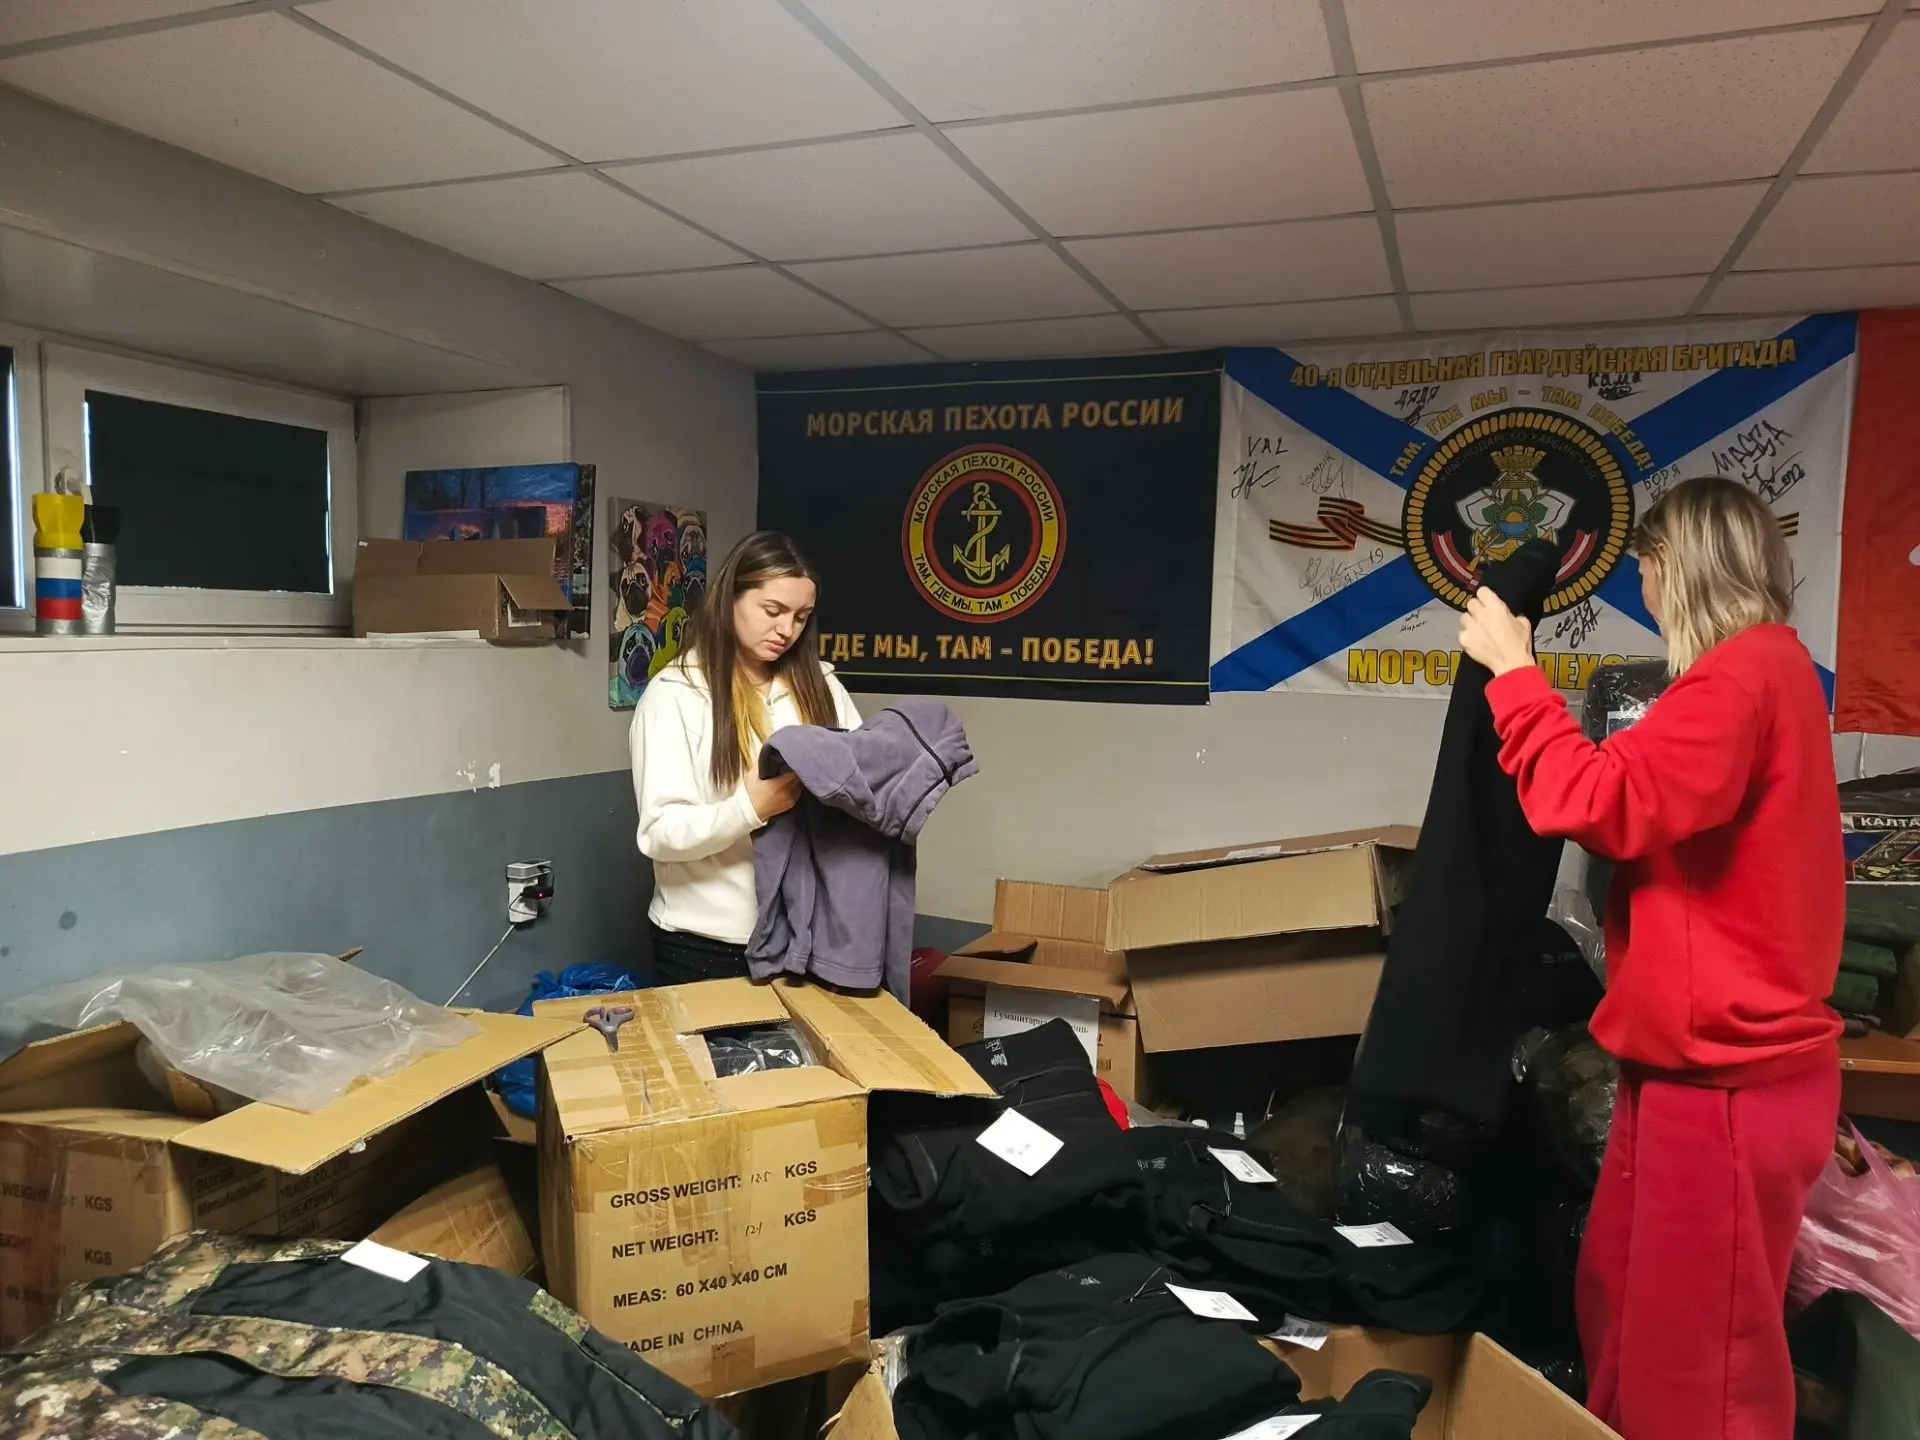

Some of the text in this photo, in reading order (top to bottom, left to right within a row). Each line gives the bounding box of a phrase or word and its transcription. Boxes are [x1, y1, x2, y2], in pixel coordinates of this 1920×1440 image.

[1290, 338, 1797, 390] 40-я ОТДЕЛЬНАЯ ГВАРДЕЙСКАЯ БРИГАДА
[805, 396, 1186, 438] МОРСКАЯ ПЕХОТА РОССИИ
[1425, 403, 1464, 436] ГДЕ
[1470, 386, 1508, 412] МЫ
[1541, 385, 1584, 410] ТАМ
[1587, 403, 1656, 472] ПОБЕДА!
[1248, 435, 1289, 458] VAL
[913, 455, 1055, 524] МОРСКАЯ ПЕХОТА РОССИИ
[914, 554, 932, 584] ТАМ,
[930, 581, 951, 601] ГДЕ
[951, 596, 974, 612] МЫ,
[978, 600, 1003, 612] ТАМ
[1010, 555, 1052, 603] ПОБЕДА!
[819, 633, 866, 661] ГДЕ
[873, 634, 928, 663] МЫ,
[936, 635, 992, 661] ТАМ
[1021, 637, 1155, 670] ПОБЕДА!
[1348, 648, 1461, 686] МОРС
[84, 1195, 113, 1212] KGS
[610, 1186, 671, 1209] GROSS
[673, 1175, 742, 1198] WEIGHT:
[784, 1160, 818, 1179] KGS
[611, 1241, 646, 1259] NET
[650, 1228, 719, 1253] WEIGHT:
[784, 1209, 817, 1228] KGS
[84, 1248, 113, 1266] KGS
[613, 1262, 788, 1308] MEAS: 60 X40 X40 CM
[668, 1331, 685, 1346] IN
[693, 1319, 744, 1341] CHINA
